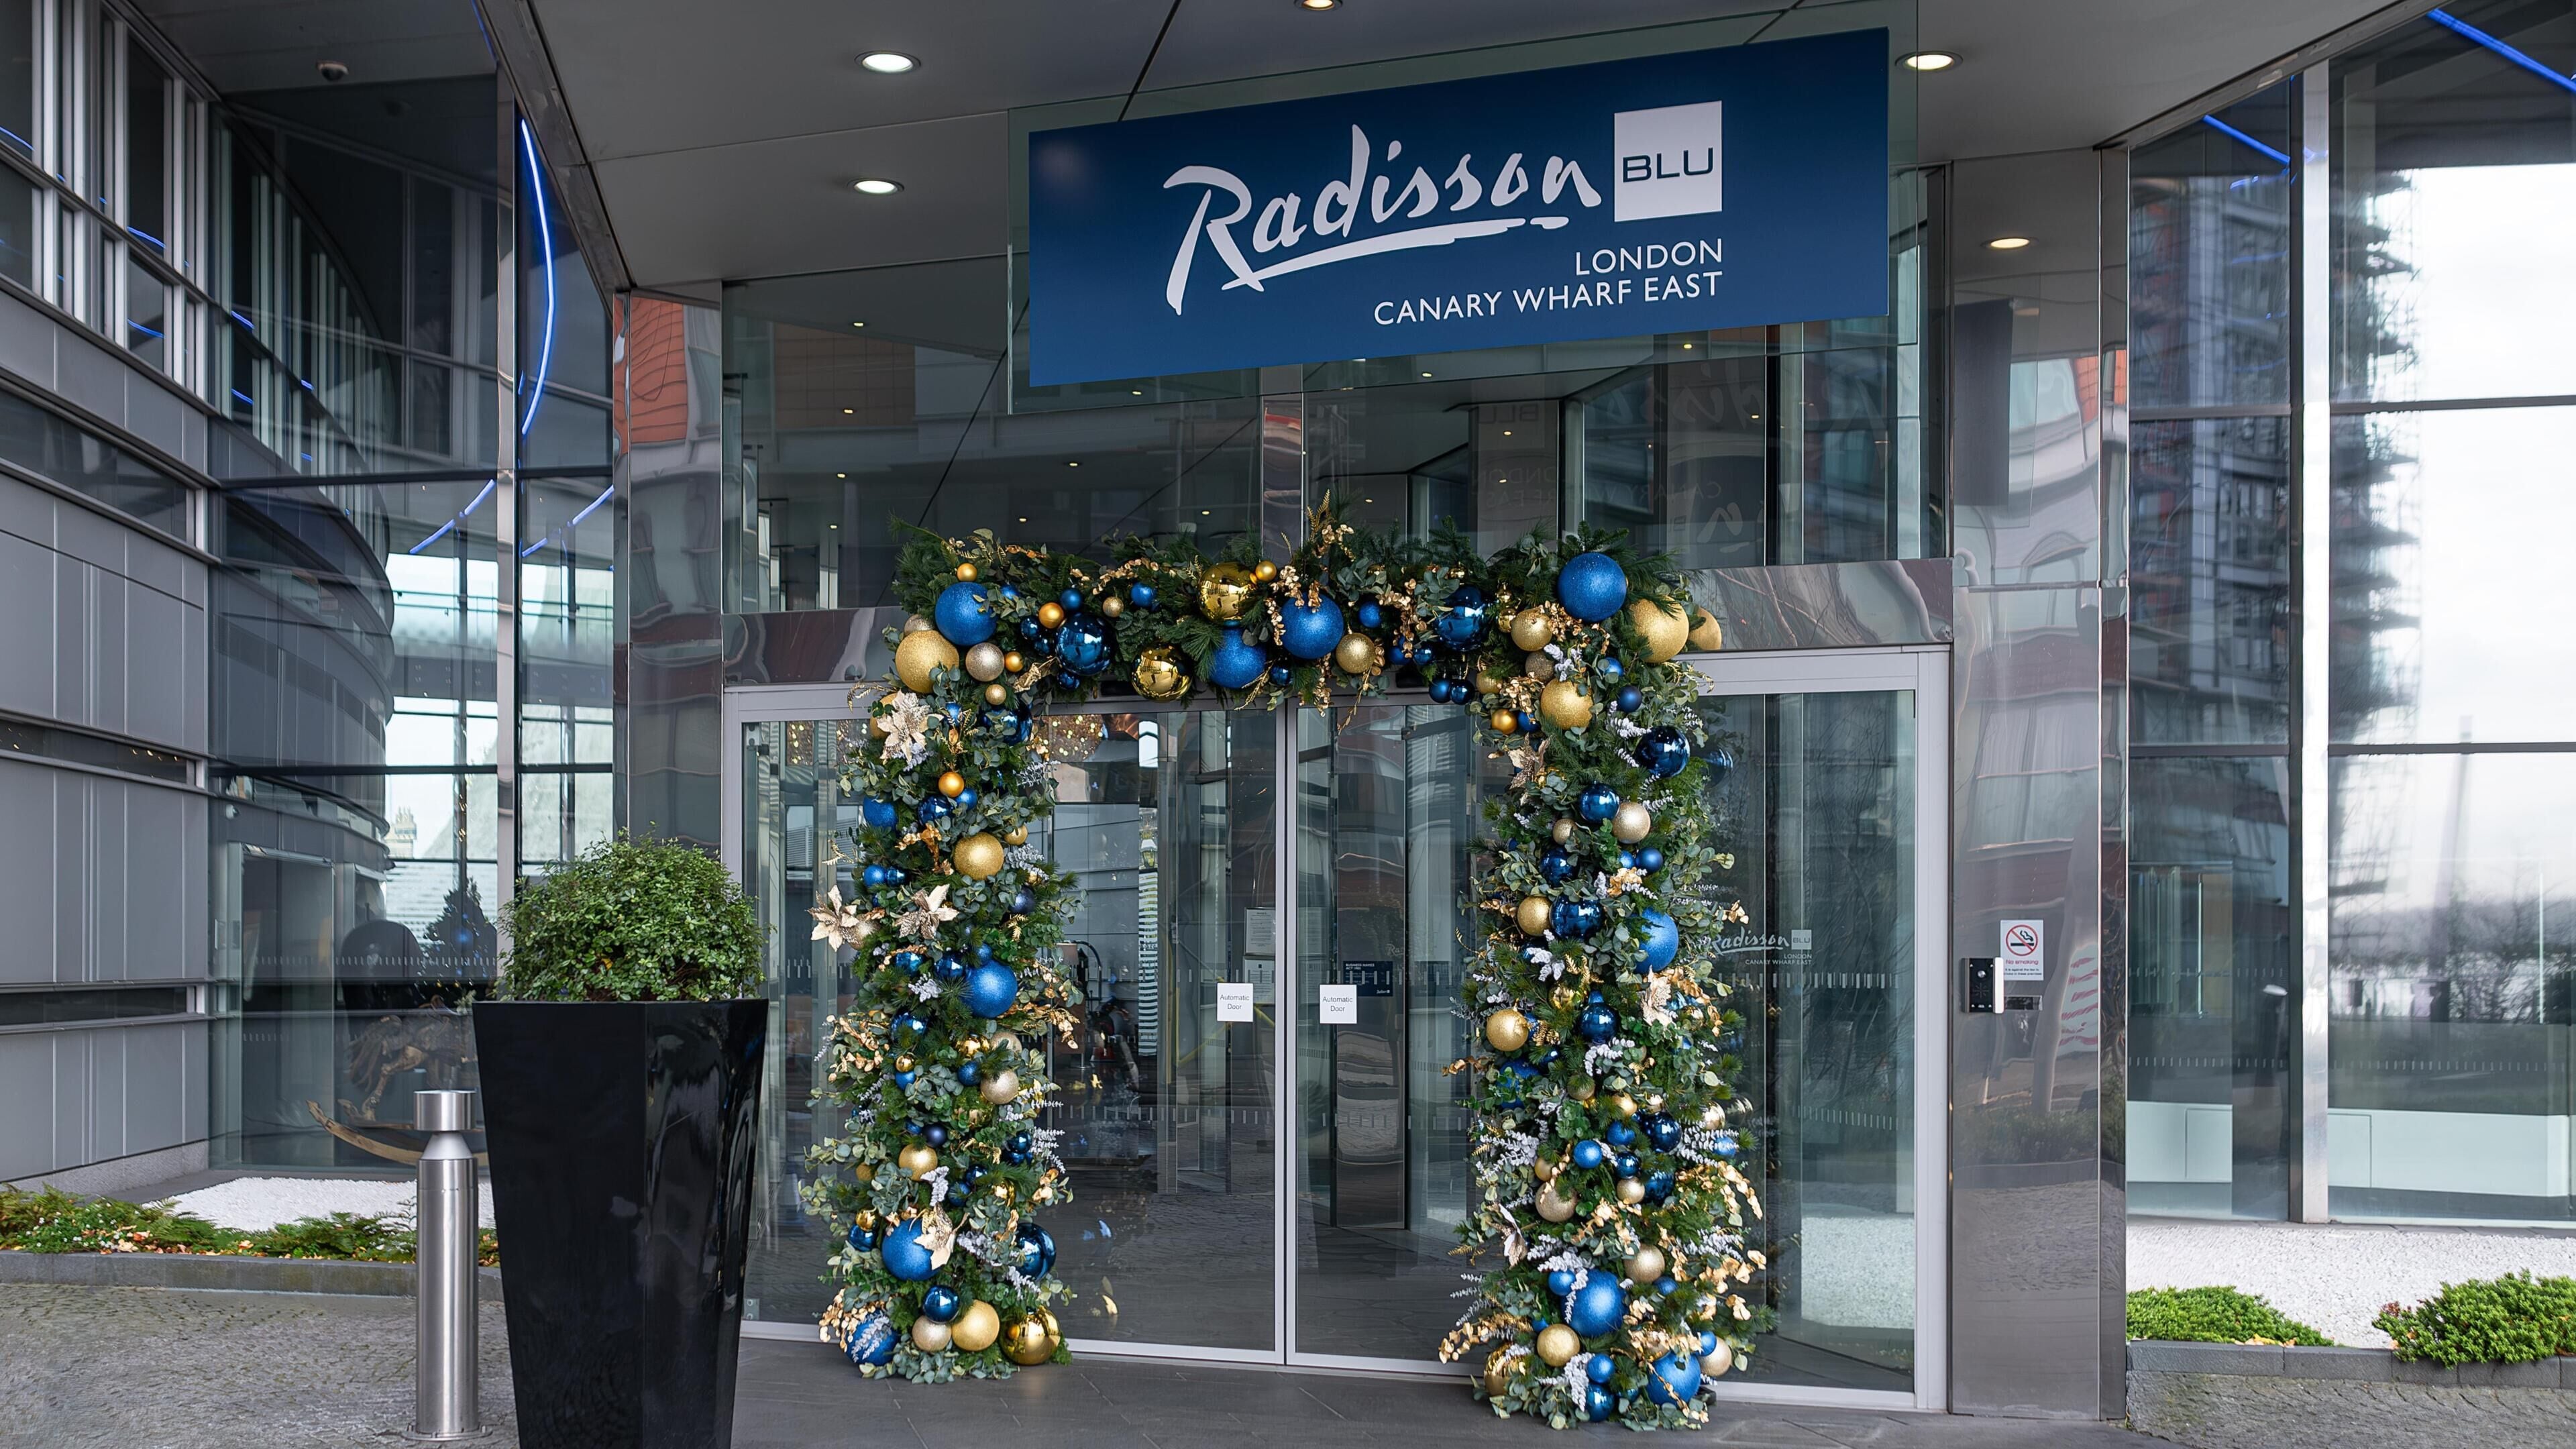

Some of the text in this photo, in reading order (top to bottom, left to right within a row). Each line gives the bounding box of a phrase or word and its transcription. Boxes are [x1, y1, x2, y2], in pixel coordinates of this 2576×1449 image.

[1164, 125, 1714, 315] Radisson BLU
[1576, 238, 1723, 276] LONDON
[1374, 270, 1723, 326] CANARY WHARF EAST
